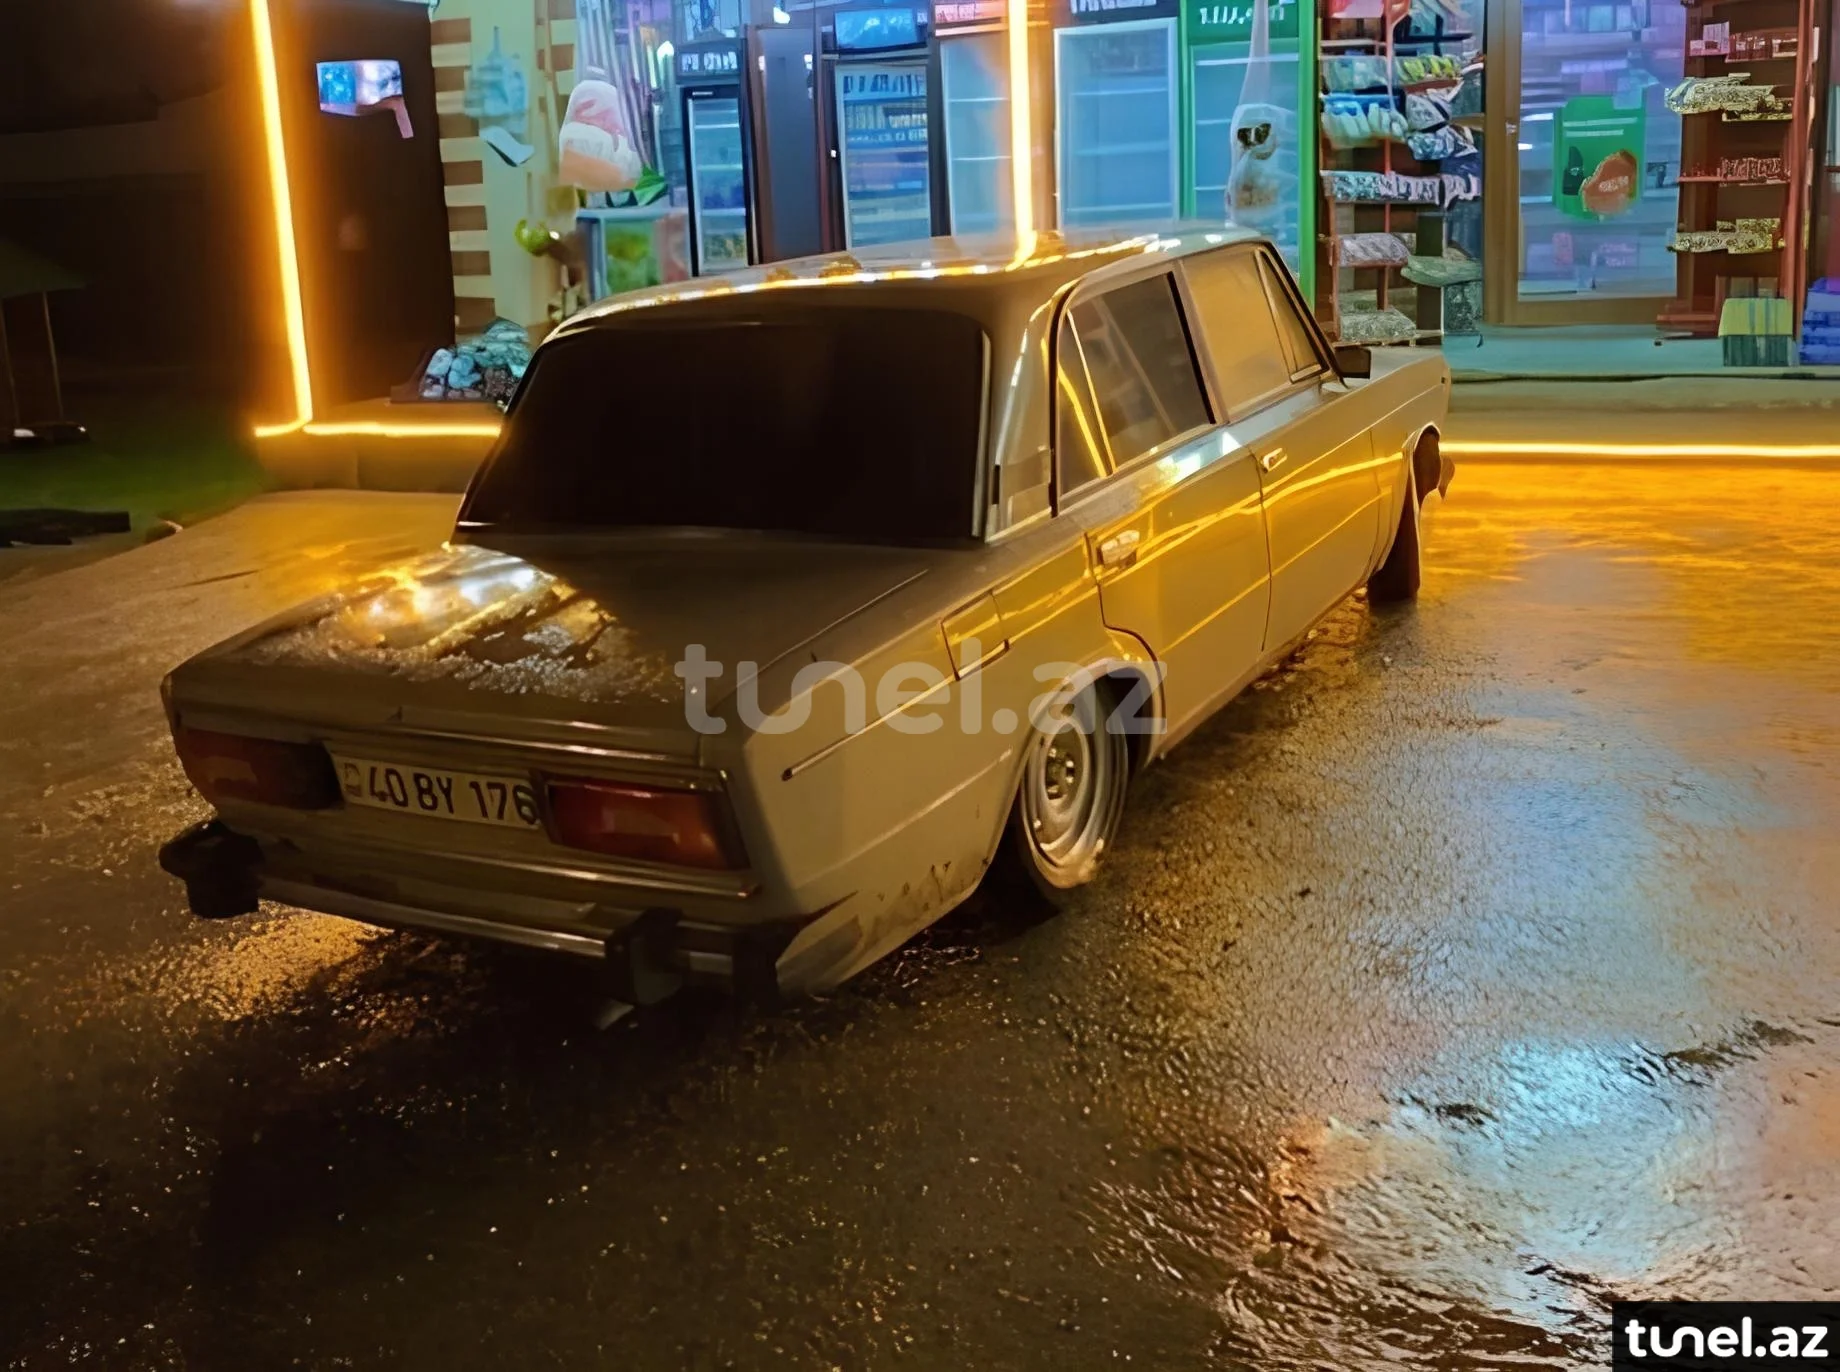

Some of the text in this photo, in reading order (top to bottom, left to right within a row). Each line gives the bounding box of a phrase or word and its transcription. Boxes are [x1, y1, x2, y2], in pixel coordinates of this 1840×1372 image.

[369, 766, 538, 825] 40 BY 176
